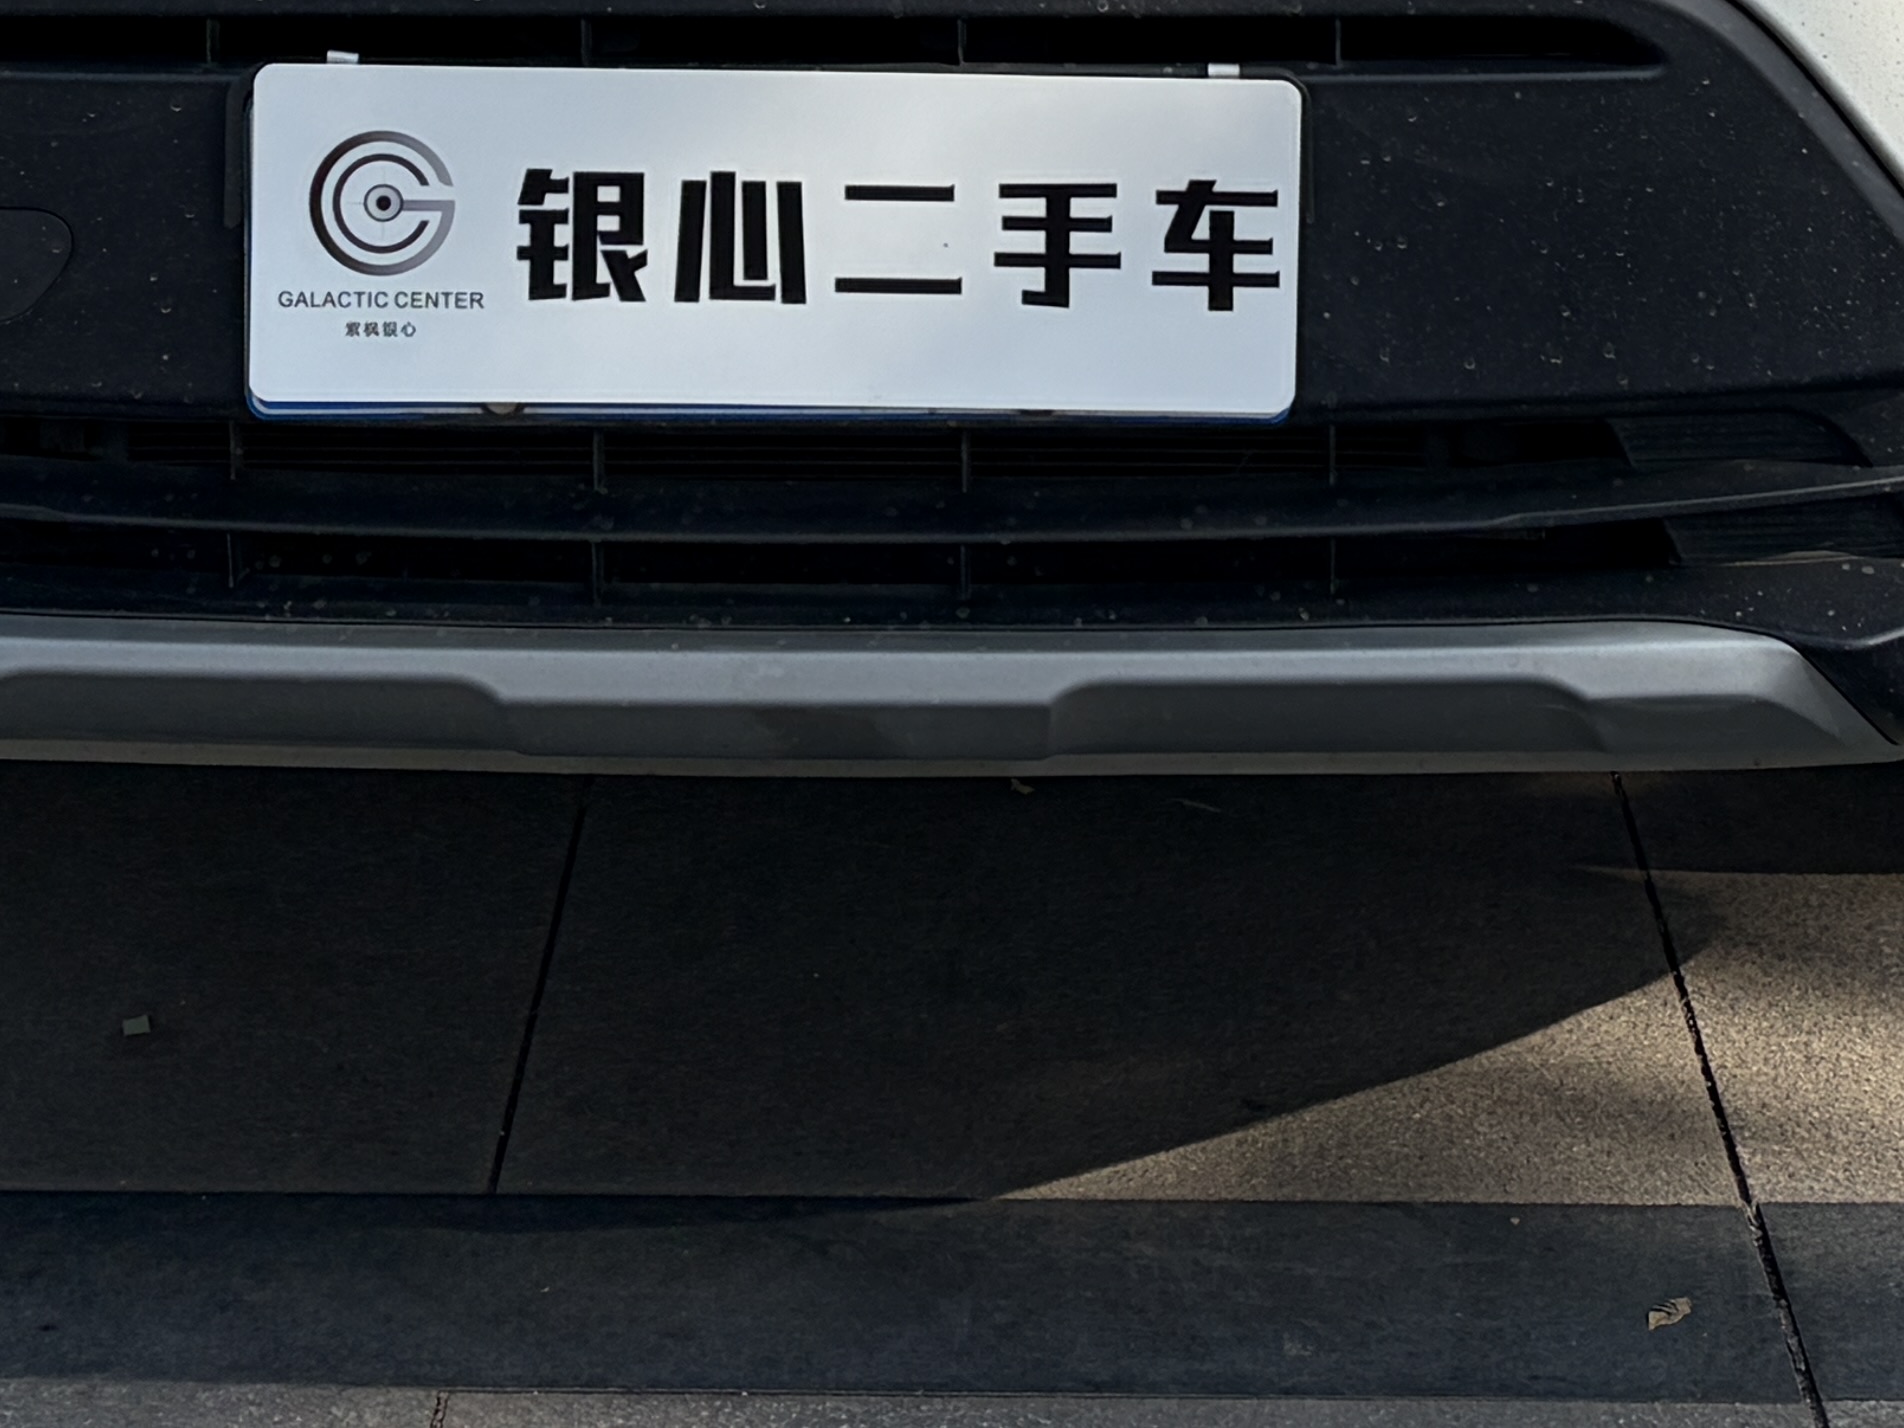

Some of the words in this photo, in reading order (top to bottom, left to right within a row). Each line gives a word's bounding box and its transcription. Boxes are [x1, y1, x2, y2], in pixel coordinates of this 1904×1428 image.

[517, 168, 1281, 313] 银心二手车
[278, 290, 389, 309] GALACTIC
[394, 291, 485, 310] CENTER
